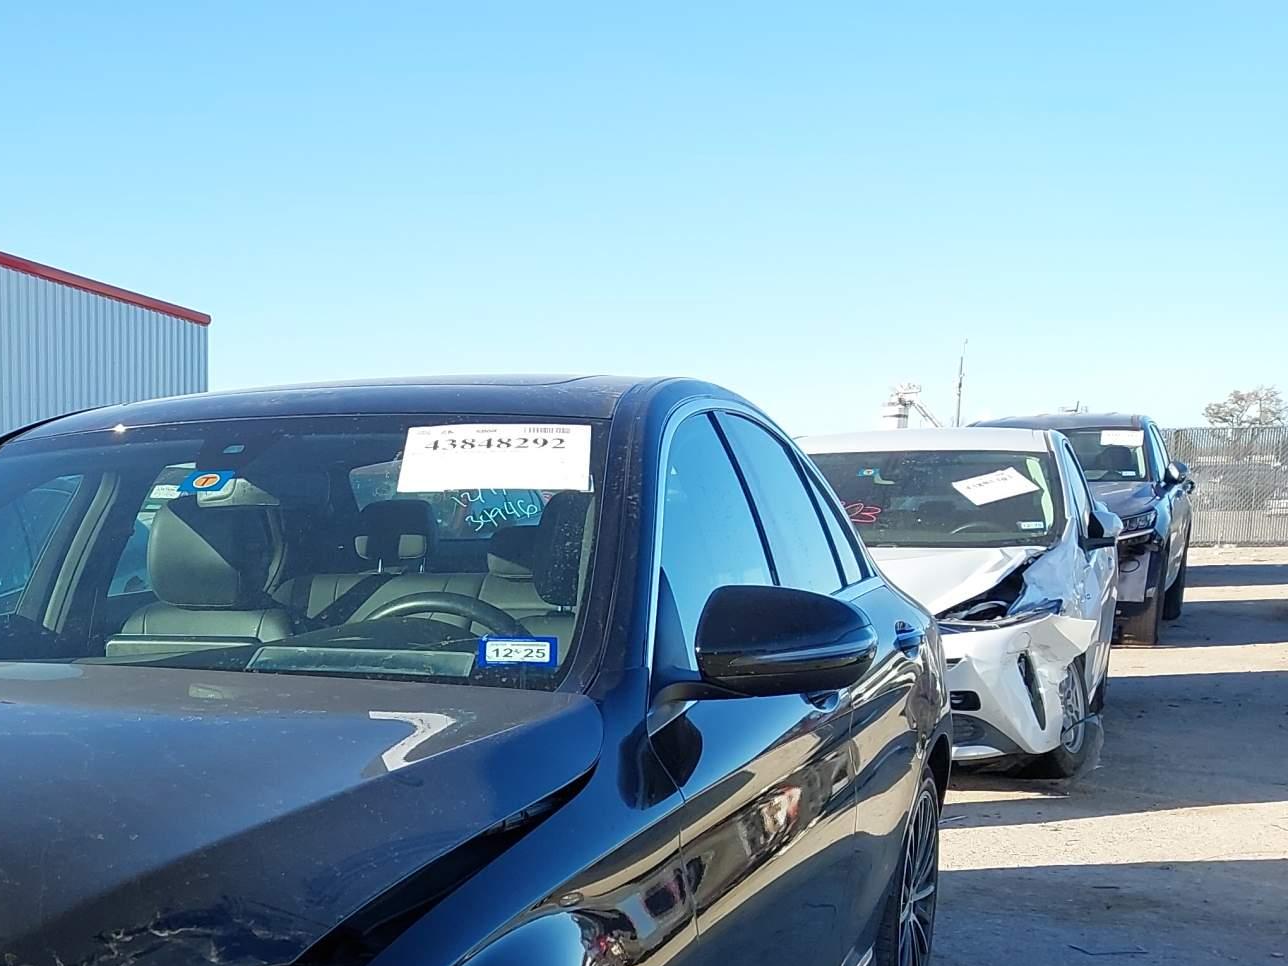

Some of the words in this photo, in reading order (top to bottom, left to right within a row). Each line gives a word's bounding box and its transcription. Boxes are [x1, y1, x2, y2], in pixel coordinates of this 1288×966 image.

[424, 437, 566, 451] 43848292
[491, 647, 514, 658] 12
[523, 647, 546, 658] 25
